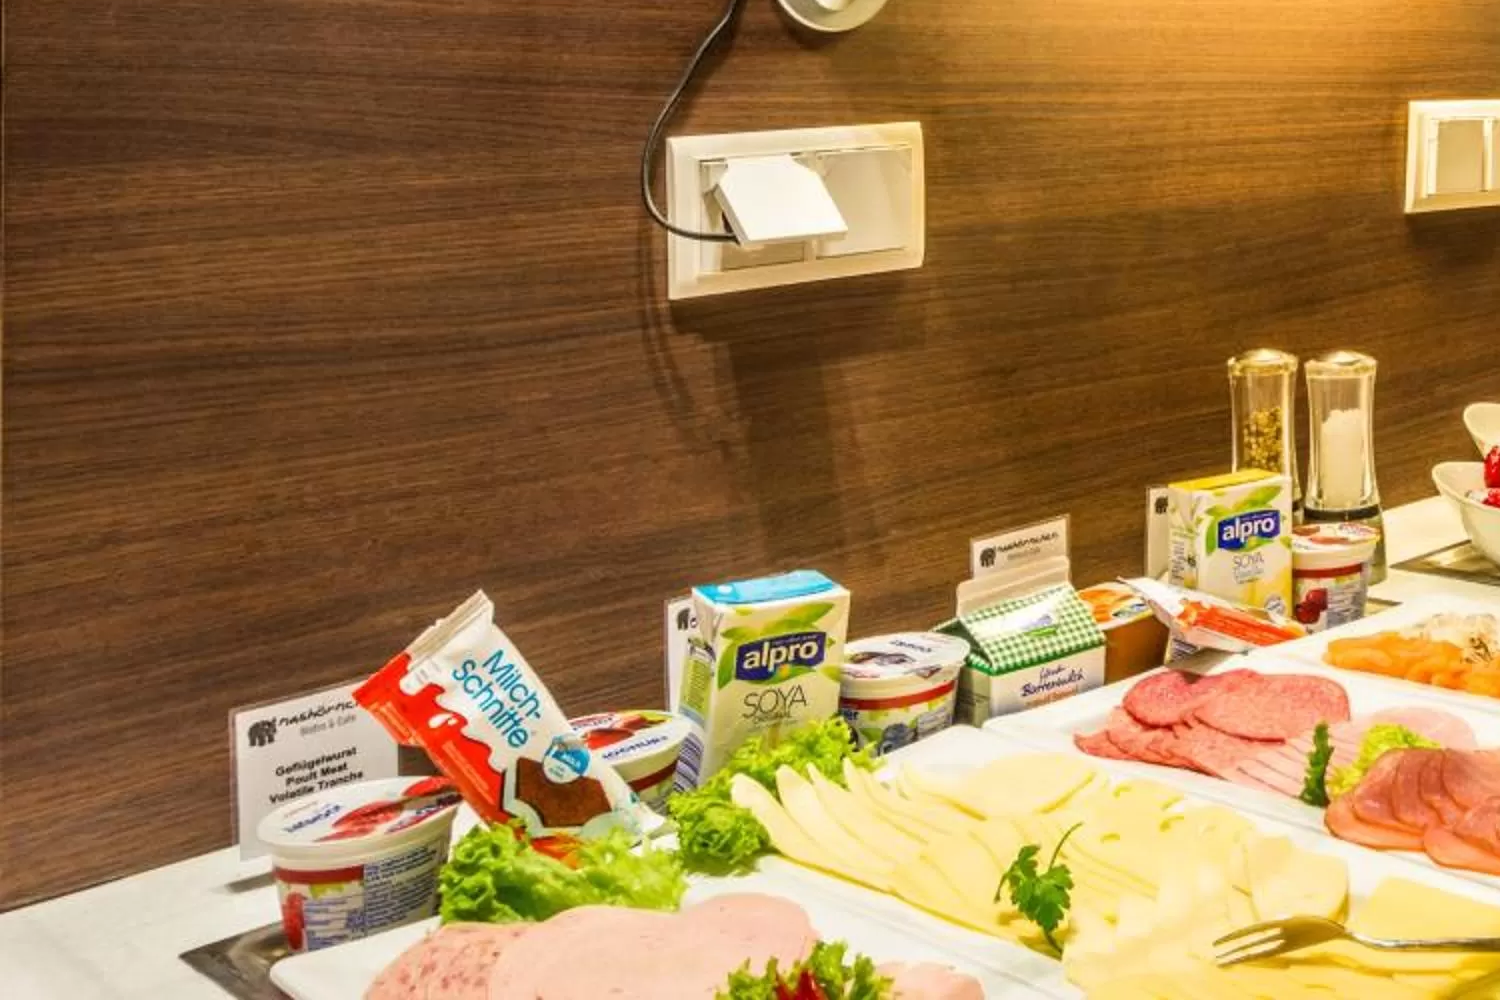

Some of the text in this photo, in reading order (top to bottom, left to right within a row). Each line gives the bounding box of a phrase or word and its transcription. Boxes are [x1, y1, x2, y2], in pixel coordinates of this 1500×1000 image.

[1221, 517, 1275, 543] alpro
[742, 640, 819, 673] alpro
[481, 649, 541, 720] Milch-
[451, 658, 529, 748] Schnitte
[742, 684, 808, 719] SOYA
[275, 746, 357, 777] Geflügelwurst
[320, 762, 348, 777] Meat
[268, 770, 364, 804] Volatile Tranche
